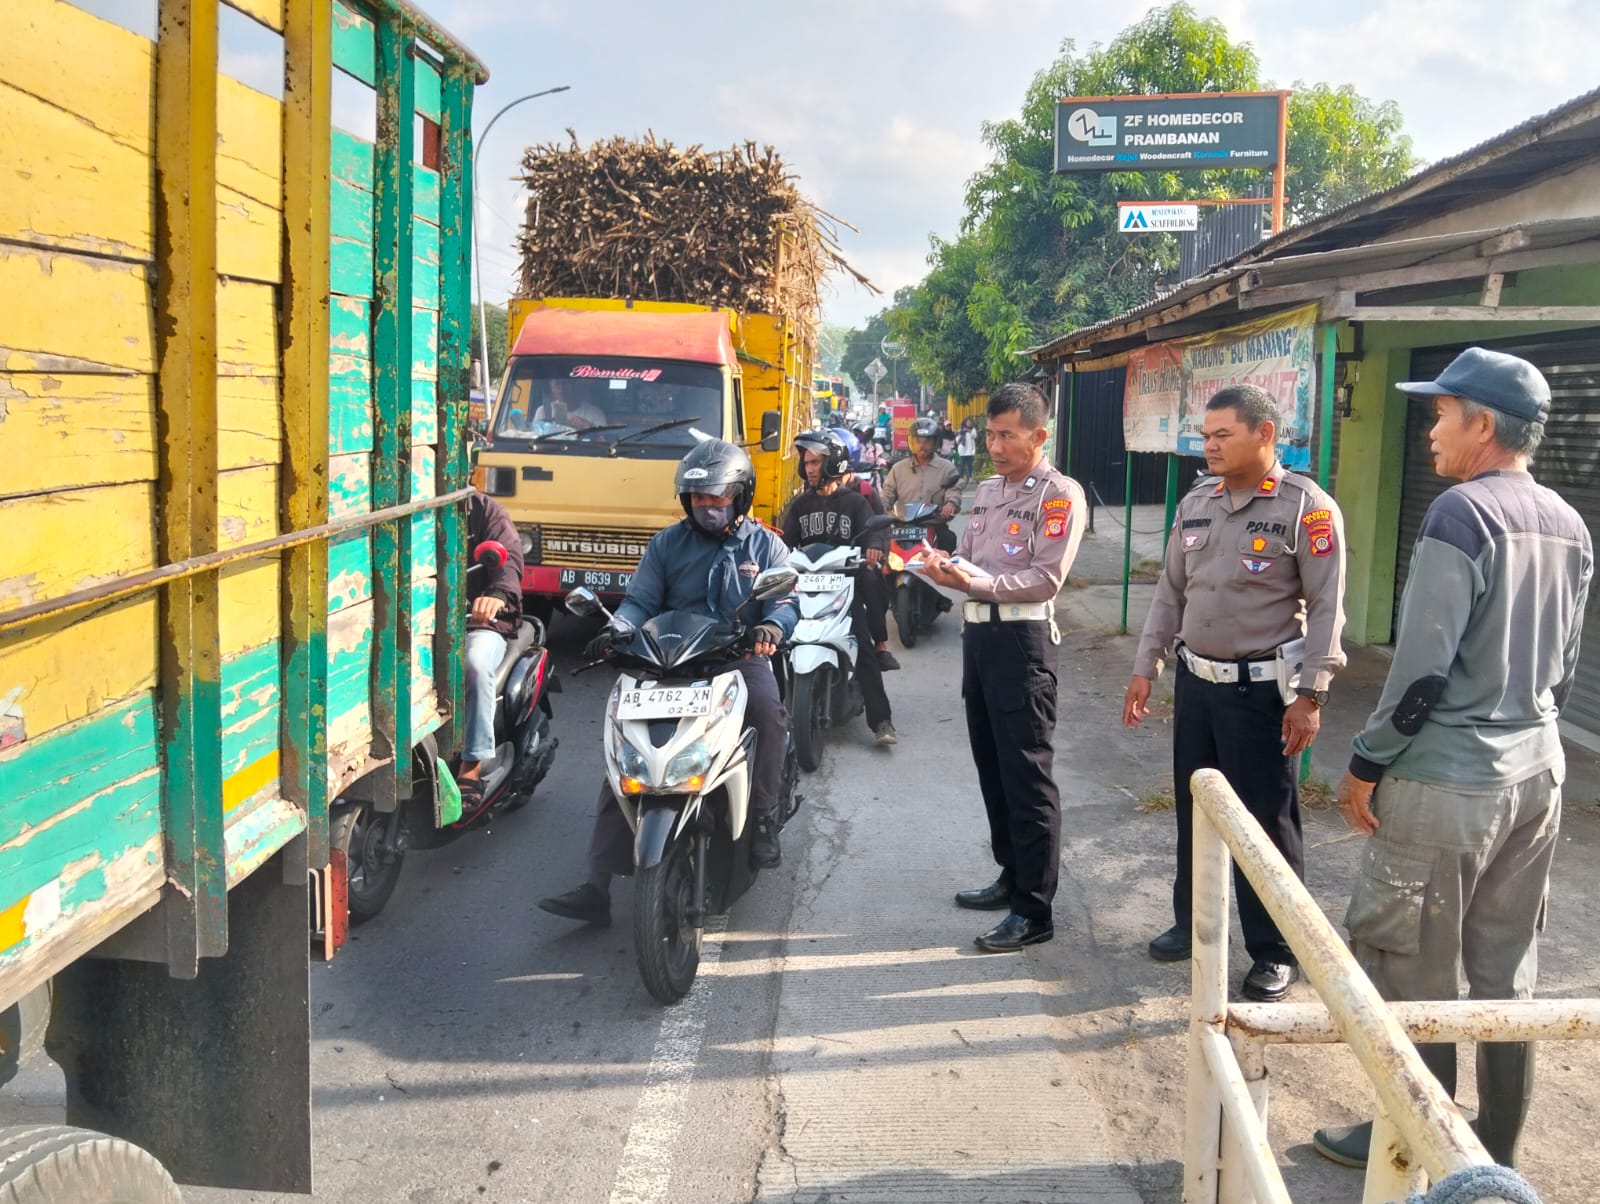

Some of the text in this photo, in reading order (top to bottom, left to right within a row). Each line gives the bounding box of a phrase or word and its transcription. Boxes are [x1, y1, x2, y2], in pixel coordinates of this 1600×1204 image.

[1124, 112, 1244, 127] ZF HOMEDECOR
[1124, 132, 1220, 146] PRAMBANAN
[1067, 153, 1115, 163] Homedecor
[1139, 151, 1192, 161] Woodencraft
[1229, 149, 1269, 158] Furniture
[1150, 218, 1195, 228] SCAFFOLDING
[1246, 520, 1287, 536] POLRI
[562, 569, 576, 584] AB
[584, 571, 611, 586] 8639
[803, 575, 826, 583] 2467
[622, 689, 711, 705] AB 4762 XN
